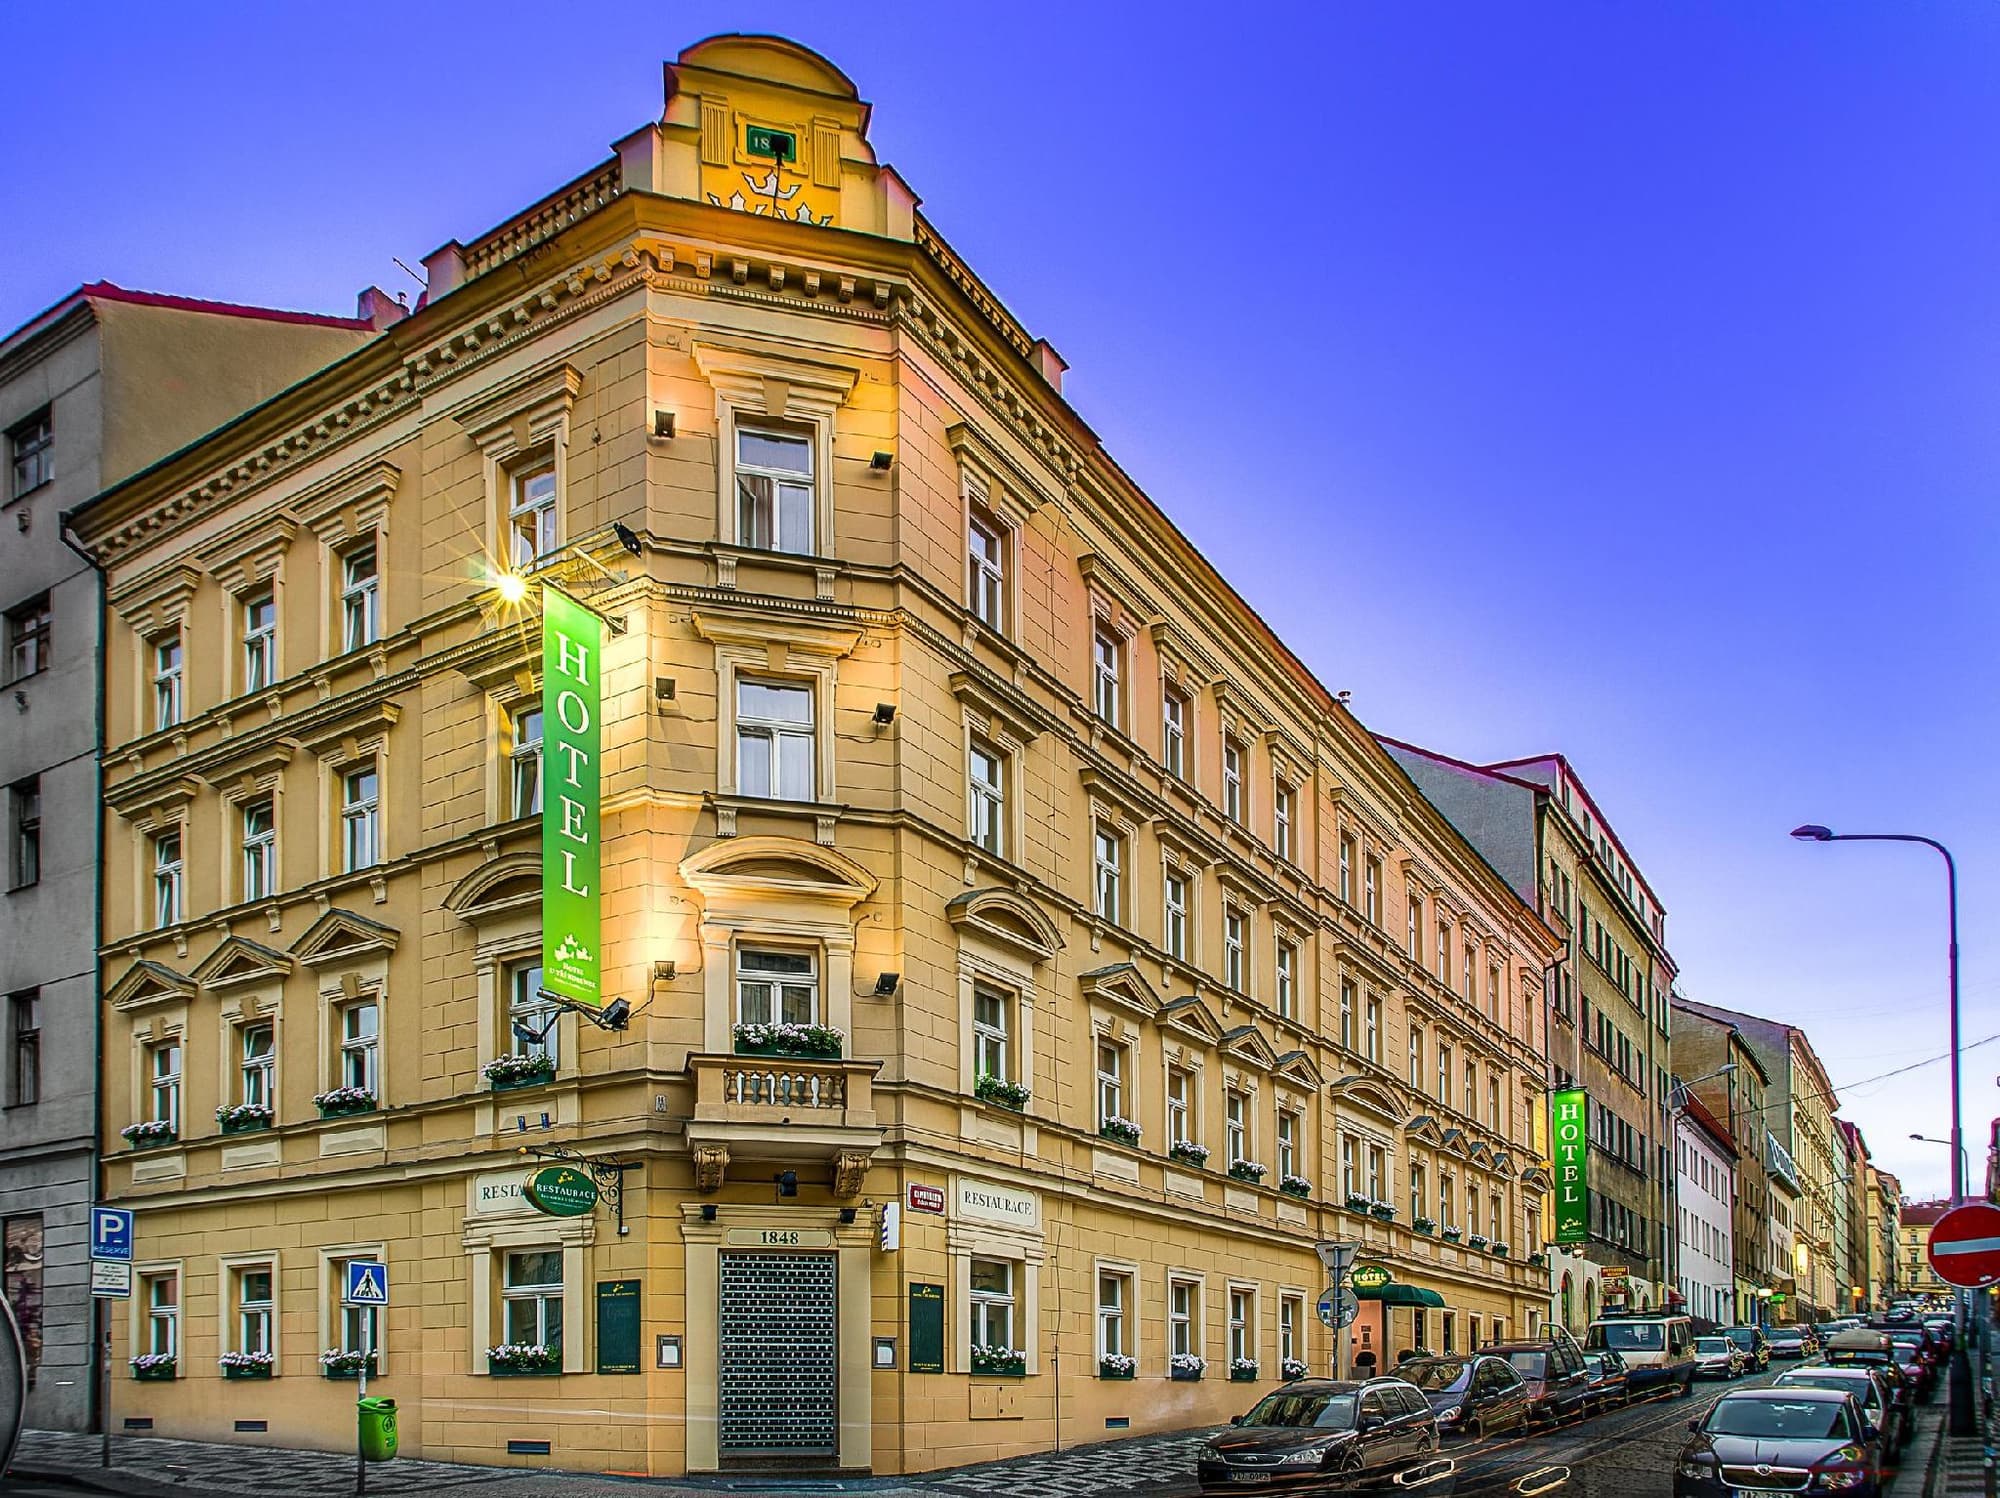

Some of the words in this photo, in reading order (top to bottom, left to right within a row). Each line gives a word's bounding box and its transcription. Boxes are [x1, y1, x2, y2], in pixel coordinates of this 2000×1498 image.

[555, 631, 590, 899] HOTEL
[1560, 1104, 1579, 1203] HOTEL
[536, 1184, 596, 1200] RESTAURACE
[964, 1190, 1032, 1216] RESTAURACE
[100, 1214, 124, 1243] P
[761, 1231, 799, 1245] 1848
[1354, 1272, 1387, 1282] HOTEL
